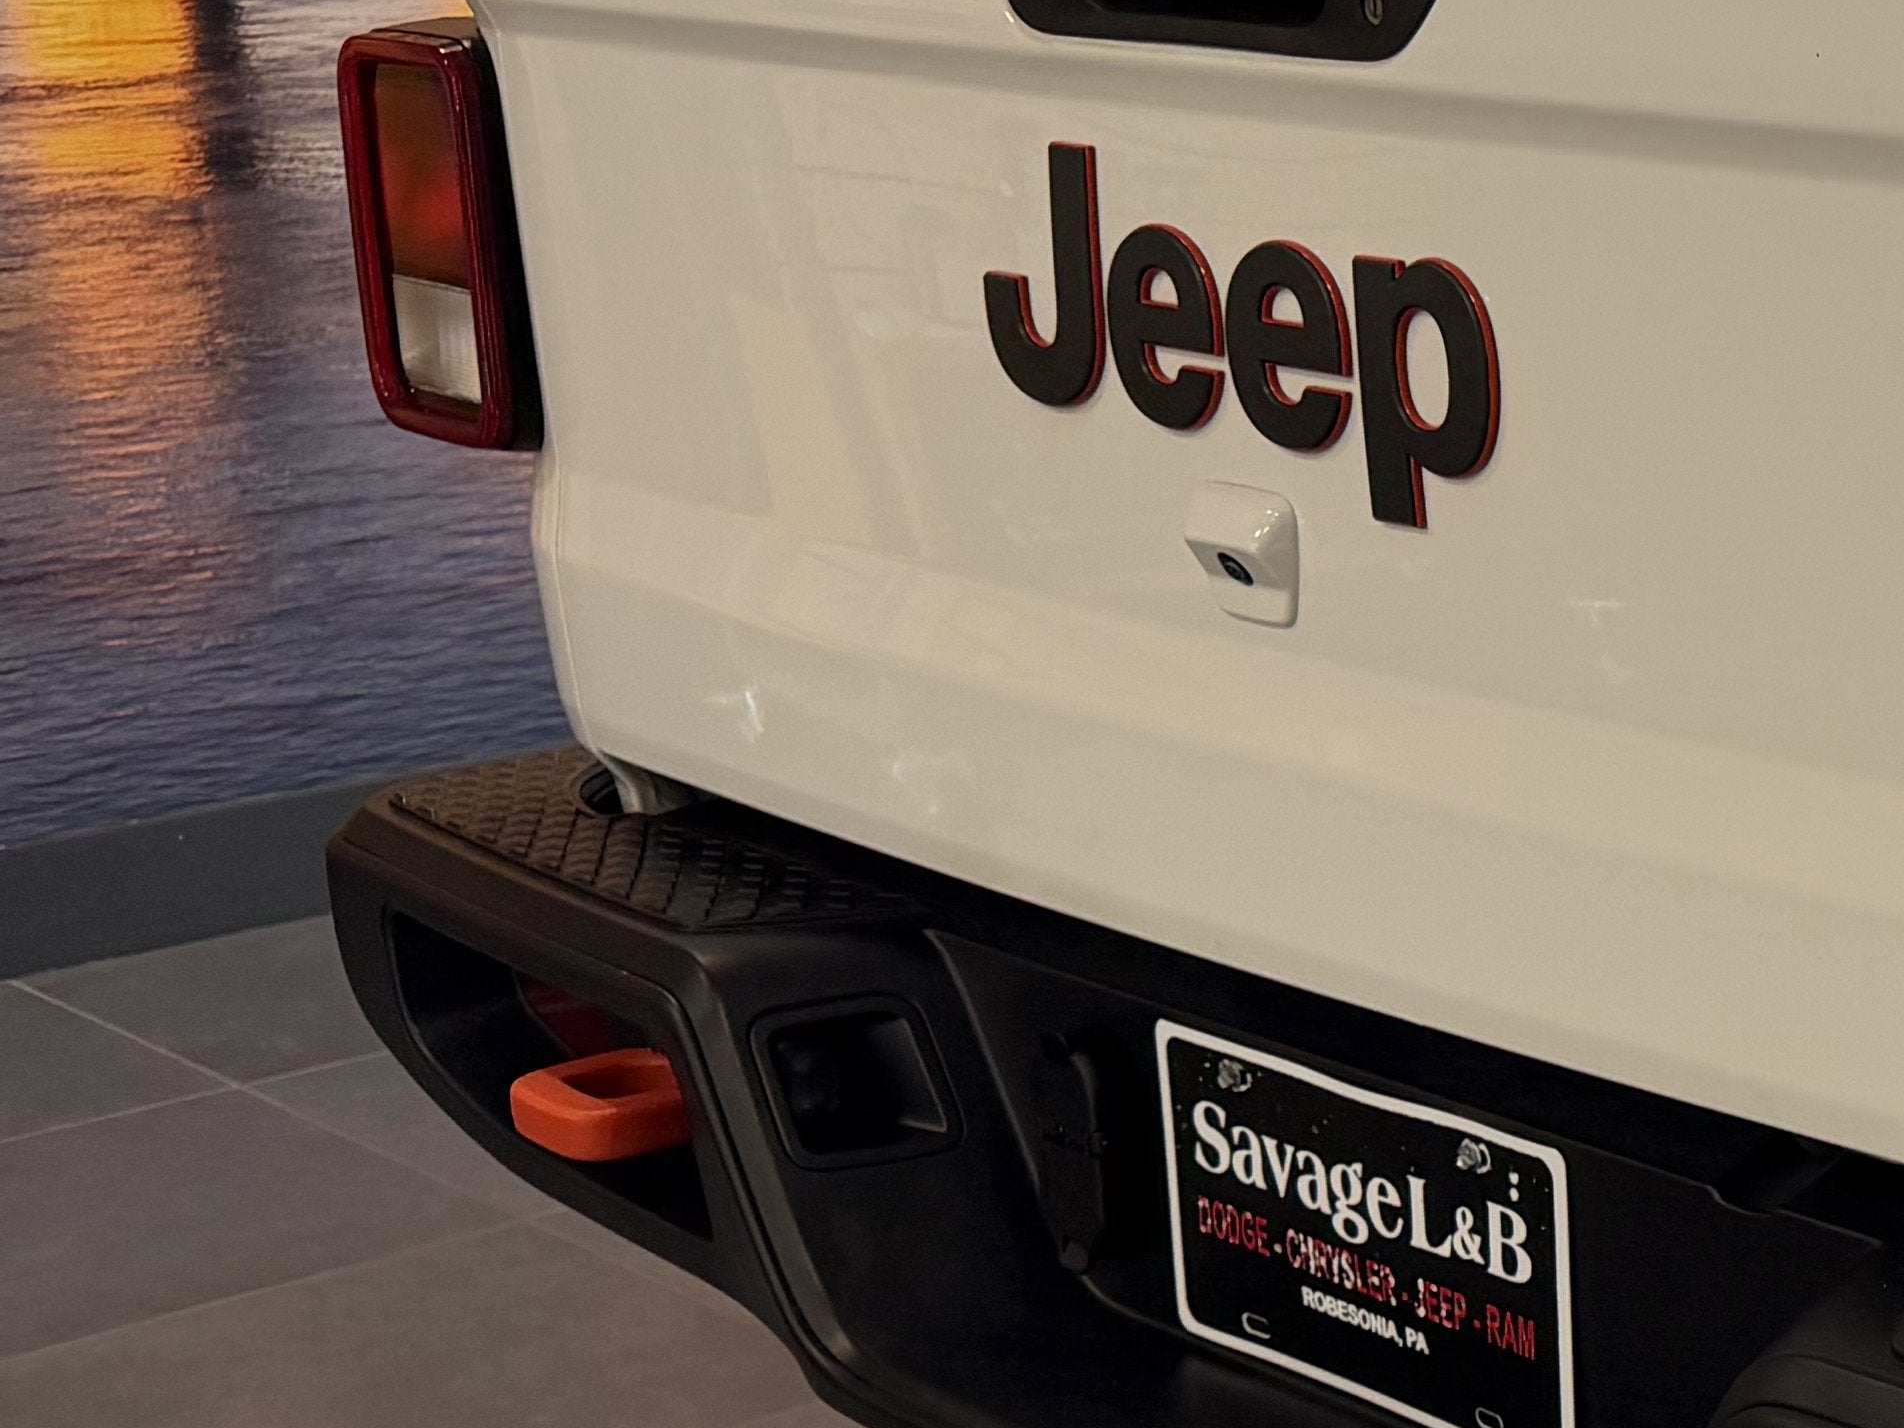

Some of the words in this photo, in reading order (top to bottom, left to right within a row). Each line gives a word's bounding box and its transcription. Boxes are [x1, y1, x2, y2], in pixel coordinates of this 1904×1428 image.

[982, 140, 1501, 528] Jeep
[1197, 1195, 1271, 1258] DODGE
[1285, 1229, 1397, 1307] CHRYSLER
[1414, 1276, 1468, 1332] JEEP
[1486, 1304, 1537, 1361] RAM
[1301, 1285, 1403, 1349] ROBESONIA,
[1405, 1327, 1430, 1356] PA
